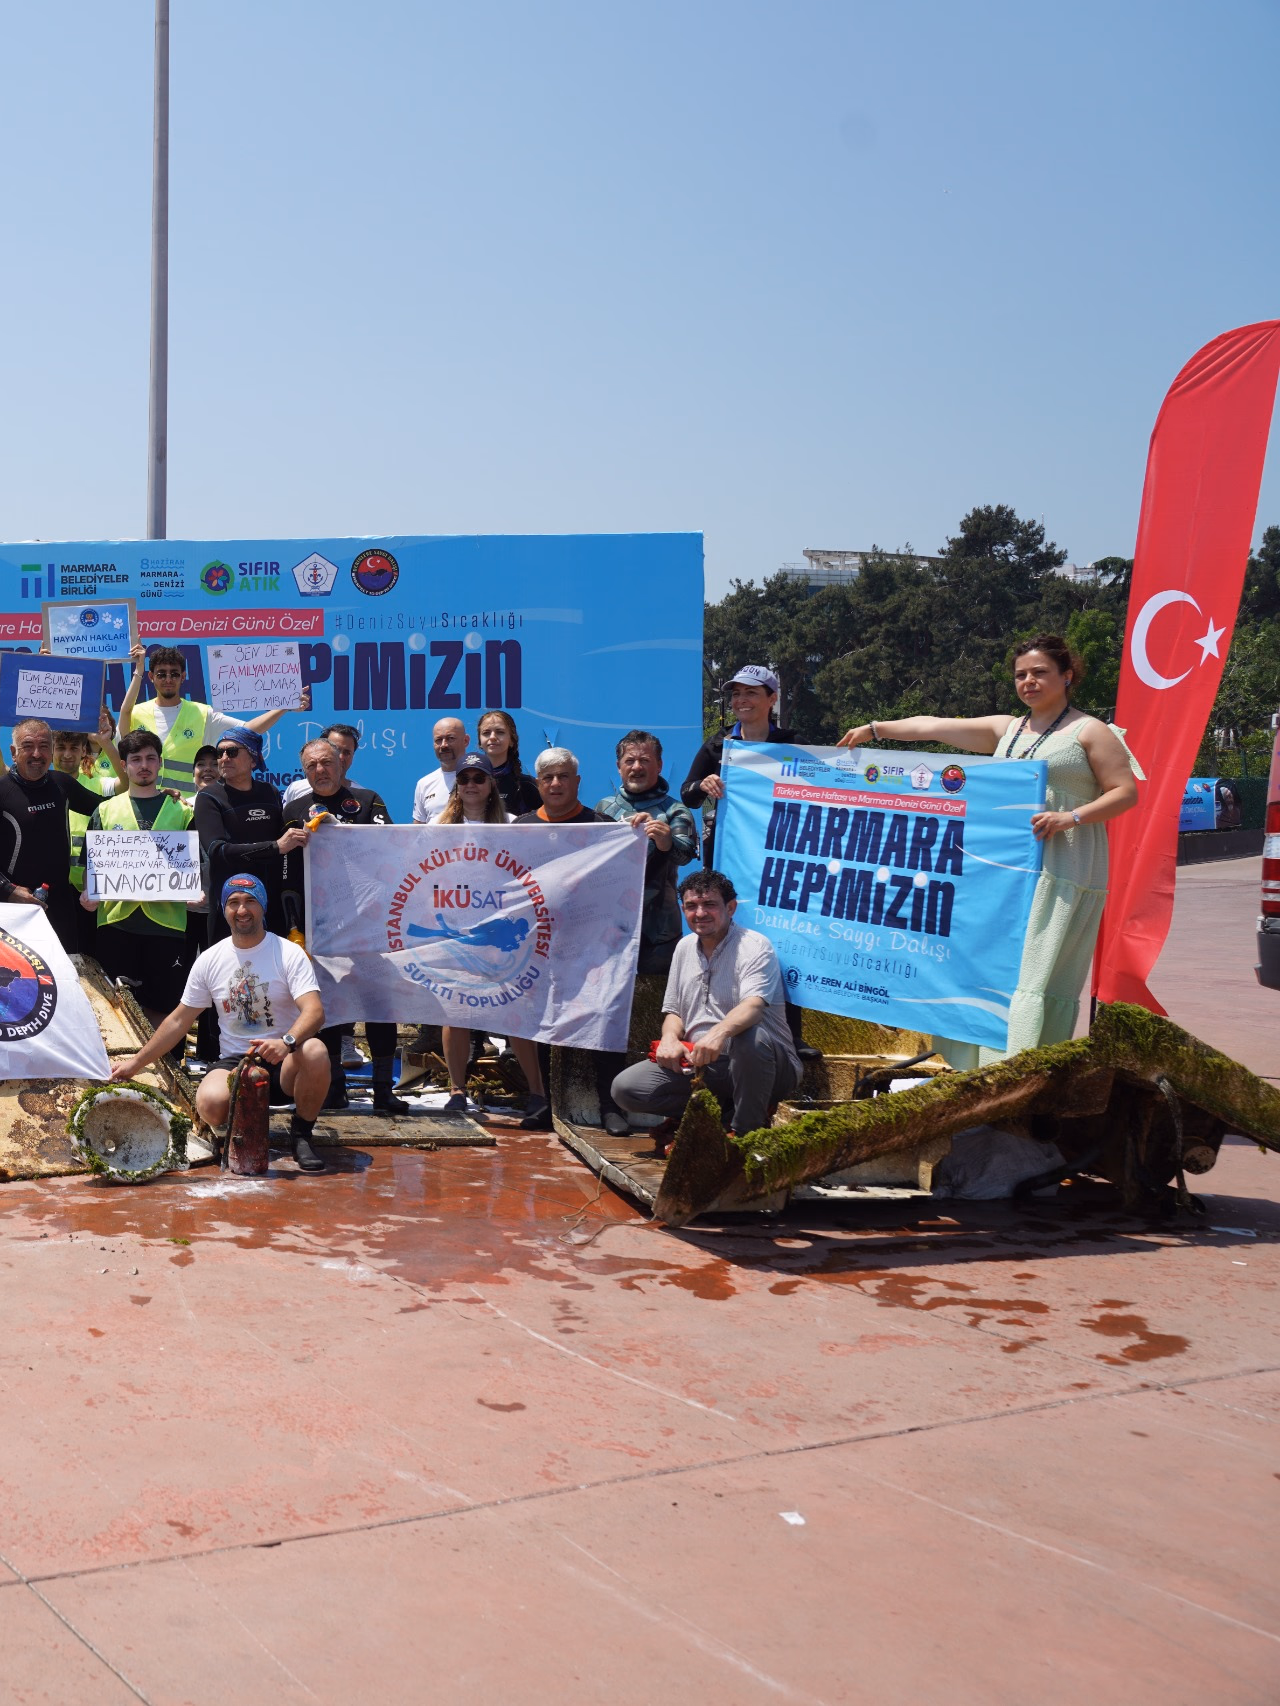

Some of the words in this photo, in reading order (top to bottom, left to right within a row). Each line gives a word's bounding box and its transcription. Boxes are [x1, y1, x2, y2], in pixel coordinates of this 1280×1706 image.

[60, 563, 117, 573] MARMARA
[140, 558, 150, 570] 8
[238, 561, 281, 576] SIFIR
[60, 573, 129, 584] BELEDİYELER
[153, 579, 185, 588] DENİZİ
[238, 576, 281, 592] ATIK
[60, 585, 97, 596] BİRLİĞİ
[140, 589, 163, 598] GÜNÜ
[179, 616, 229, 632] Denizi
[232, 615, 276, 631] Günü
[53, 635, 88, 643] HAYVAN
[89, 633, 128, 642] HAKLARI
[64, 644, 118, 654] TOPLULUĞU
[264, 644, 279, 657] DE
[20, 671, 40, 684] TÜM
[44, 672, 82, 688] BUNLAR
[254, 677, 297, 691] OLMAK
[882, 765, 905, 776] SIFIR
[800, 788, 821, 799] Çevre
[857, 795, 894, 806] Marmara
[894, 797, 920, 809] Denizi
[919, 800, 942, 811] Günü
[27, 801, 56, 813] mares
[764, 800, 966, 876] MARMARA
[87, 848, 102, 859] BU
[148, 860, 166, 869] VAR
[168, 870, 201, 891] OLUN
[418, 842, 489, 875] KÜLTÜR
[494, 849, 555, 960] ÜNİVERSİTESİ
[433, 884, 507, 909] İKÜSAT
[753, 907, 821, 936] Derinlere
[828, 921, 881, 952] Saygı
[889, 930, 952, 963] Dalışı
[4, 936, 45, 971] DALIŞI
[403, 962, 453, 1001] SUALTI
[457, 965, 540, 1008] TOPLULUĞU
[805, 974, 819, 984] AV.
[820, 976, 842, 989] EREN
[843, 980, 858, 991] ALİ
[859, 982, 890, 998] BİNGÖL
[6, 1017, 43, 1038] DEPTH
[38, 992, 53, 1020] DIVE
